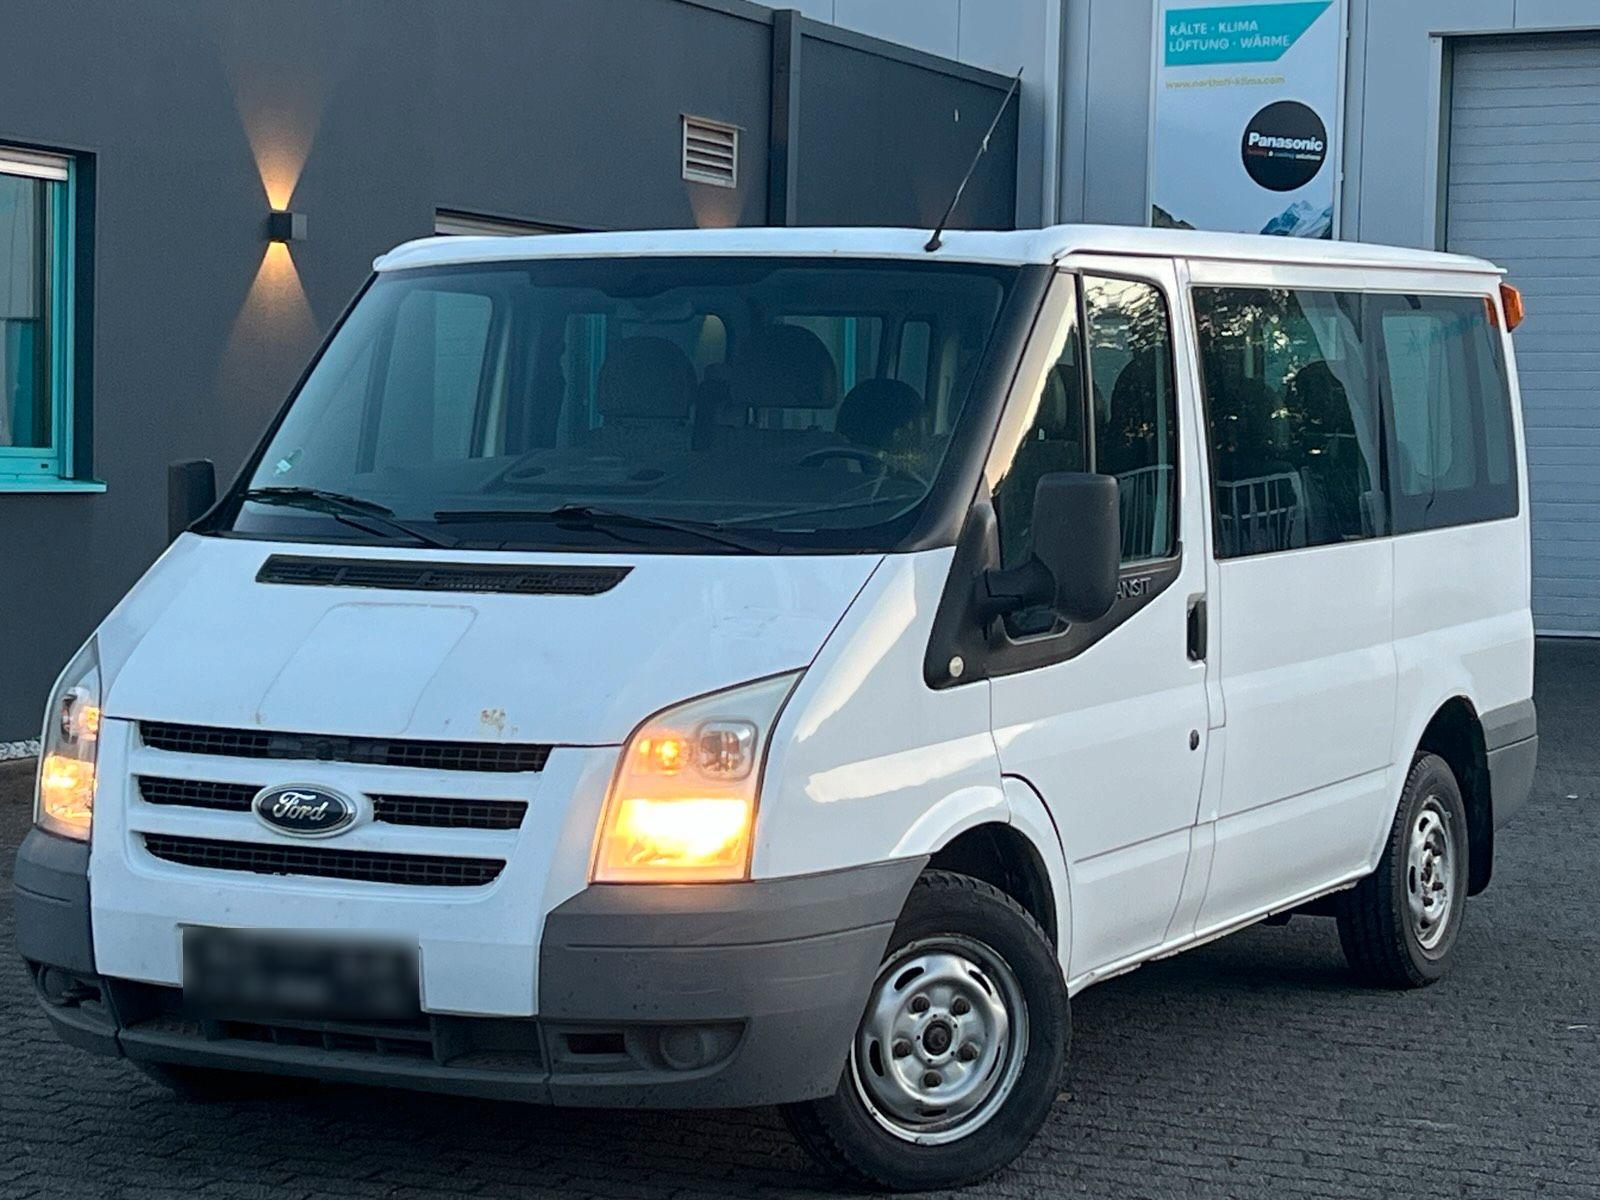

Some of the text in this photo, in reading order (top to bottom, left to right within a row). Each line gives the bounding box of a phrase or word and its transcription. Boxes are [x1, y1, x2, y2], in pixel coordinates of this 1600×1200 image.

[1169, 20, 1258, 36] KÄLTE KLIMA
[1168, 34, 1290, 53] LÜFTUNG WÄRME
[1248, 131, 1324, 152] Panasonic
[273, 791, 330, 821] Ford
